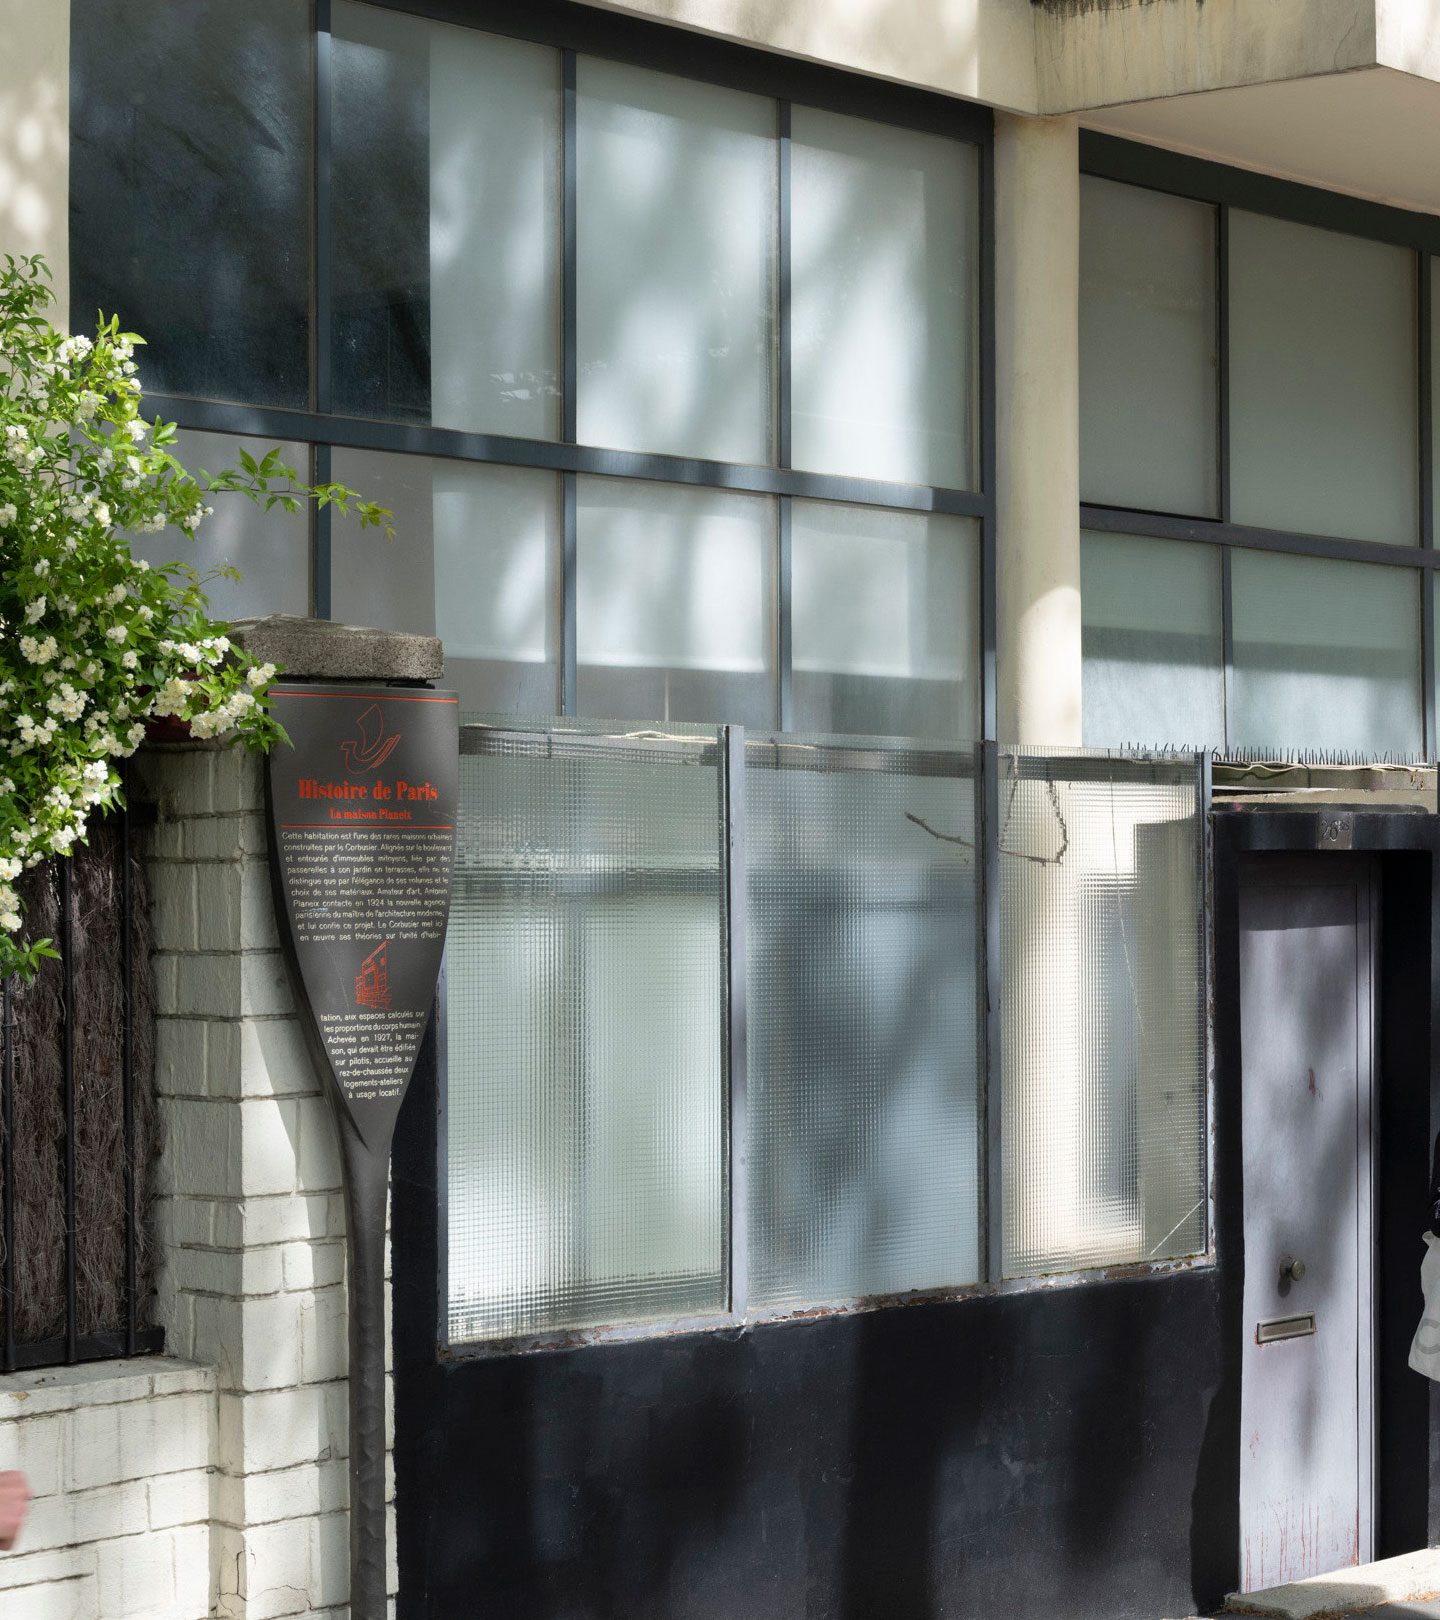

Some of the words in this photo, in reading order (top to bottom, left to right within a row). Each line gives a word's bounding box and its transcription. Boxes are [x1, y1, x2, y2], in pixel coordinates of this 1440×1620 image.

[299, 779, 368, 800] Histoire
[373, 781, 392, 800] de
[396, 781, 438, 801] Paris
[330, 807, 342, 819] La
[344, 808, 377, 820] maison
[378, 808, 412, 820] Planeix
[282, 832, 302, 840] Cette
[304, 832, 340, 840] habitation
[284, 843, 323, 851] construites
[288, 865, 328, 875] passerelles
[353, 865, 372, 875] jardin
[289, 876, 322, 886] distingue
[291, 888, 310, 896] choix
[367, 898, 385, 906] 1924
[396, 898, 421, 906] nouvelle
[389, 920, 420, 928] Corbusier
[321, 1014, 343, 1022] tation,
[359, 1013, 386, 1021] espaces
[387, 1011, 413, 1019] calculés
[335, 1024, 372, 1034] proportions
[381, 1024, 399, 1032] corps
[328, 1035, 357, 1044] Achevée
[374, 1034, 392, 1042] 1927,
[396, 1033, 402, 1041] la
[406, 1032, 419, 1040] mai-
[332, 1048, 346, 1056] son,
[347, 1047, 358, 1055] qui
[359, 1045, 378, 1053] devait
[395, 1043, 416, 1051] édifiée
[349, 1057, 371, 1067] pilotis,
[374, 1055, 402, 1064] accueille
[339, 1067, 392, 1077] rez-de-chaussée
[344, 1077, 403, 1089] logements-ateliers
[356, 1091, 376, 1099] usage
[379, 1088, 401, 1097] locatif.
